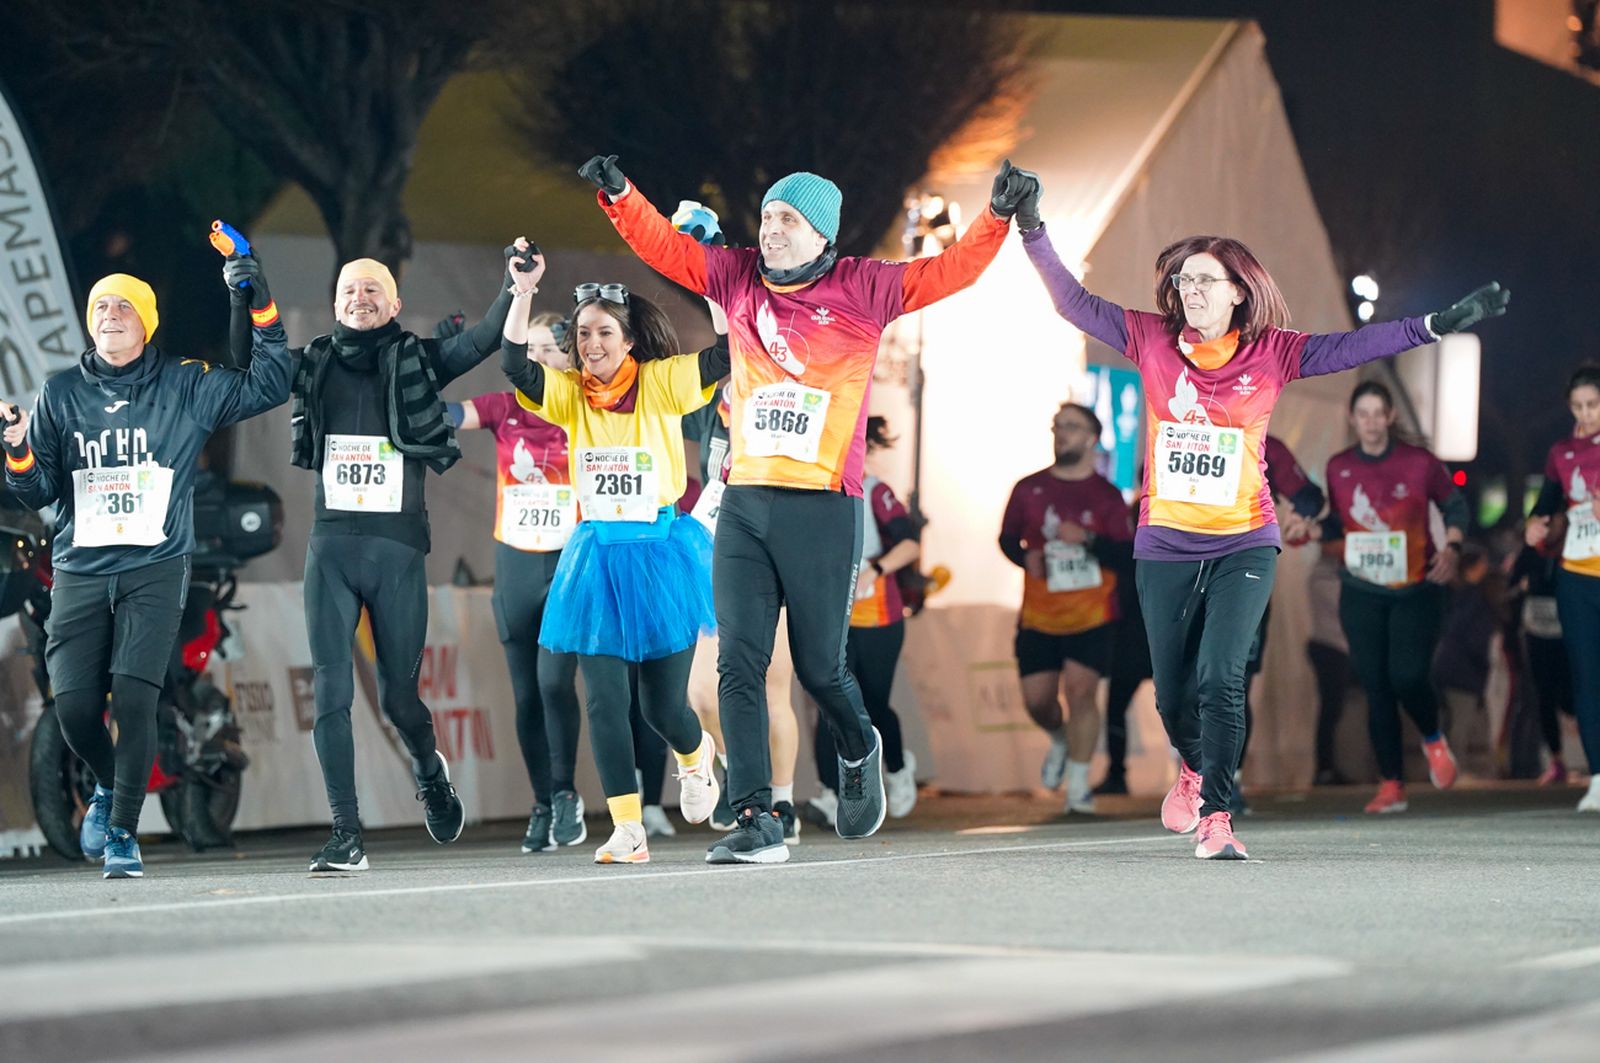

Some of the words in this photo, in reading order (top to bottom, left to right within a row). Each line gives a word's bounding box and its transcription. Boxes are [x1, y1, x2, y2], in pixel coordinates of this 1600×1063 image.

[769, 341, 788, 363] 43
[755, 408, 809, 434] 5868
[362, 444, 371, 452] DE
[1200, 433, 1211, 442] DE
[336, 463, 386, 485] 6873
[586, 464, 602, 472] SAN
[1167, 451, 1226, 478] 5869
[594, 473, 643, 496] 2361
[95, 492, 145, 516] 2361
[518, 508, 561, 528] 2876
